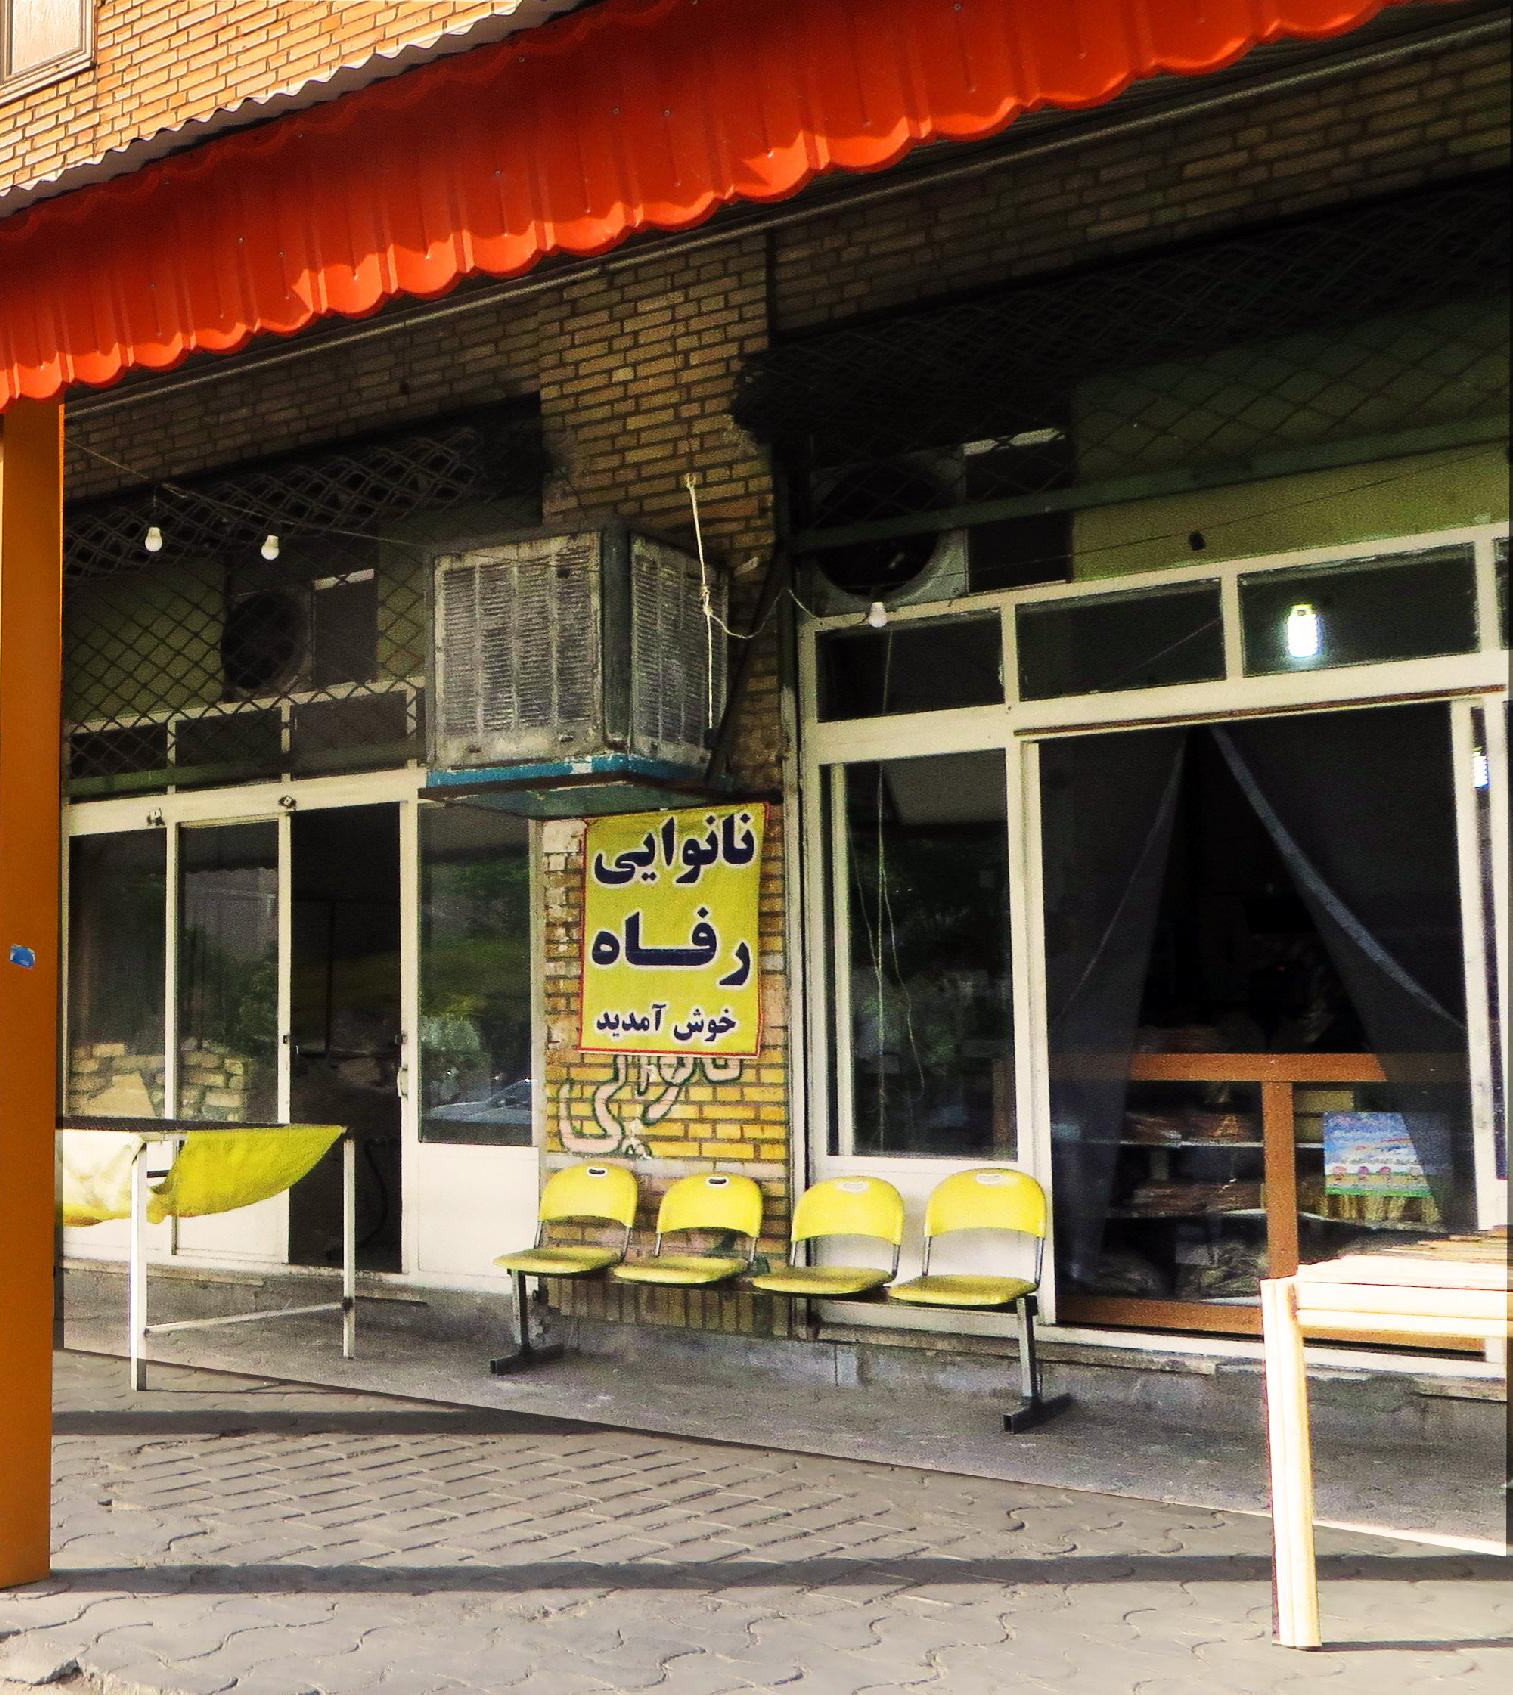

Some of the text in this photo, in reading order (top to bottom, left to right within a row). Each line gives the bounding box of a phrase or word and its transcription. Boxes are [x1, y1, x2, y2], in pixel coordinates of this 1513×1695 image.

[593, 811, 756, 884] نانوایی
[591, 906, 752, 987] رفاه
[596, 1003, 737, 1042] خوش آمدید
